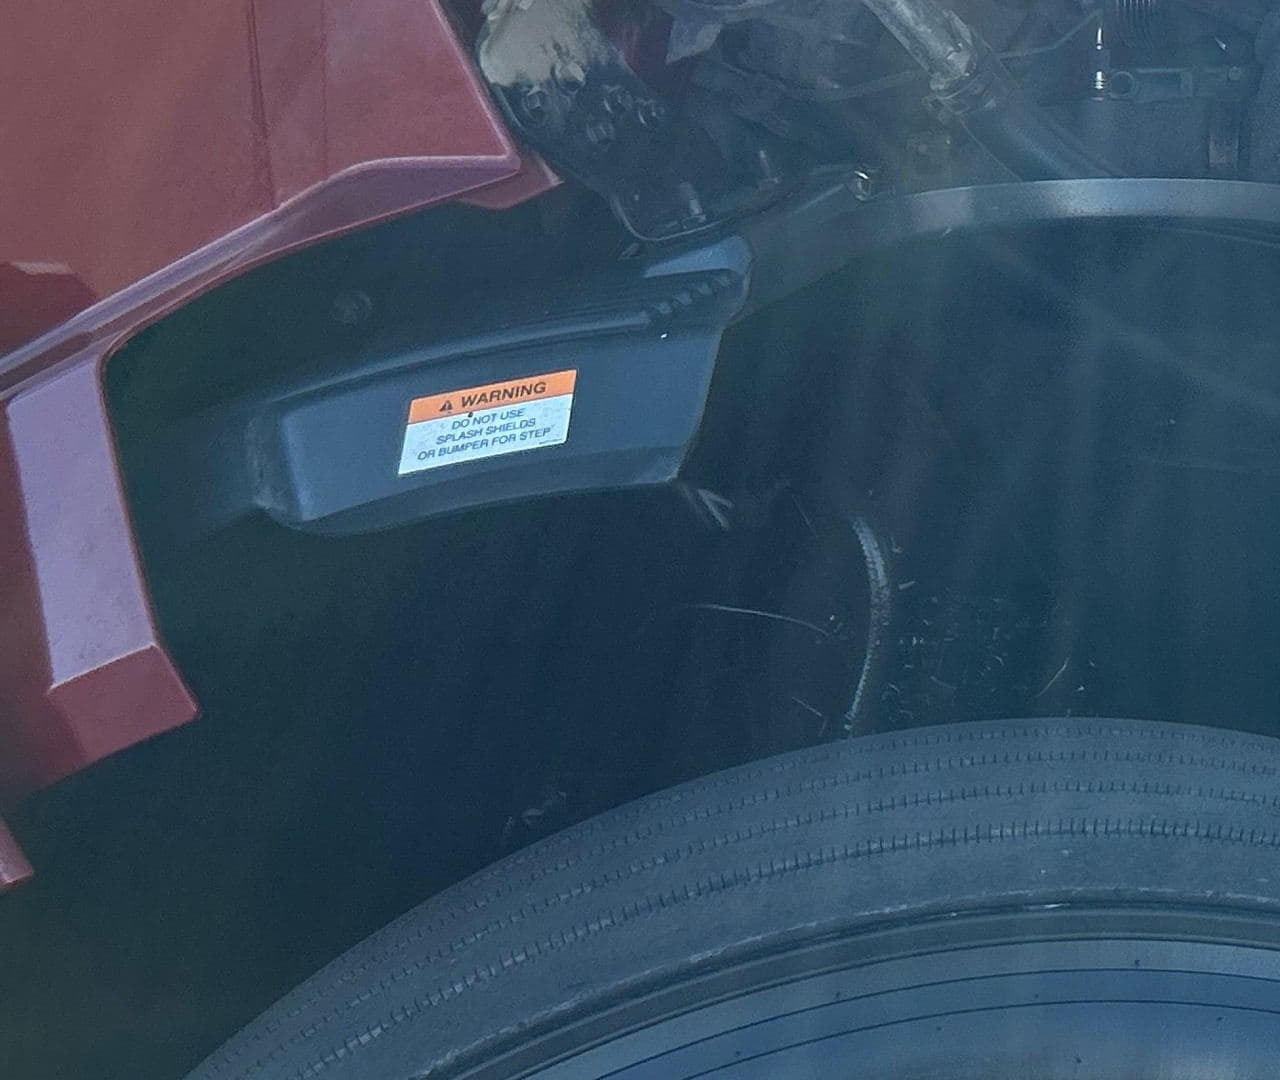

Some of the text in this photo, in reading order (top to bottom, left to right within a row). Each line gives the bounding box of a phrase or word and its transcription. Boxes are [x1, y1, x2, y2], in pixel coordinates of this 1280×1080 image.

[461, 382, 547, 408] WARNING
[436, 418, 536, 445] SPLASH SHIELDS
[452, 408, 526, 430] DO NOT USE
[417, 450, 435, 461] OR
[437, 439, 488, 457] BUMPER
[491, 433, 516, 446] FOR
[519, 426, 551, 442] STEP
